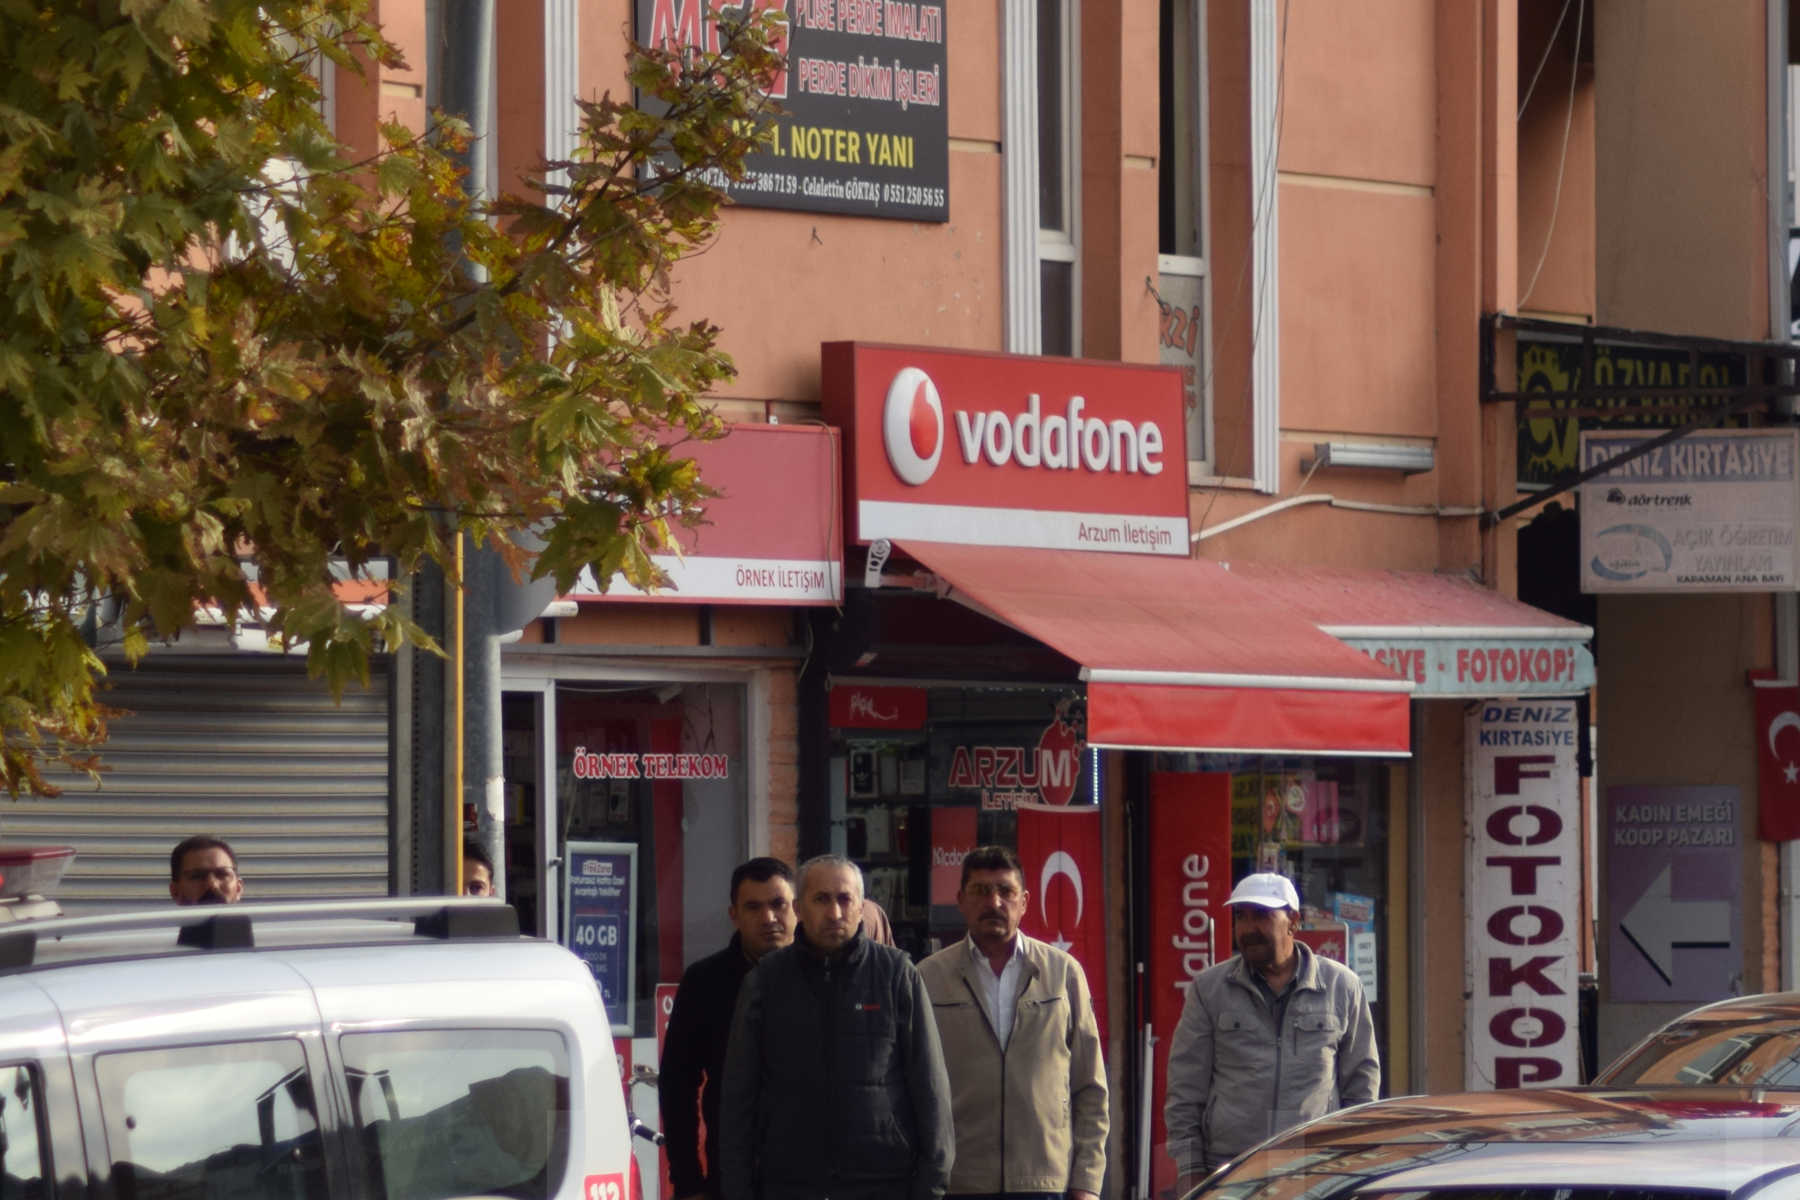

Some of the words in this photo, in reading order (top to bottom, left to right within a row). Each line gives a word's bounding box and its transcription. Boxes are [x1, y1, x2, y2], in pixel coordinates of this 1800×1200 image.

[838, 0, 883, 36] PERDE
[885, 0, 942, 44] İMALATI
[798, 57, 847, 96] PERDE
[848, 55, 892, 101] DİKİM
[894, 59, 940, 110] İŞLERİ
[791, 125, 861, 165] NOTER
[866, 132, 914, 169] YANI
[803, 175, 845, 198] Celalettin
[845, 177, 881, 208] GÖKTAŞ
[955, 392, 1164, 475] vodafone
[1591, 444, 1664, 476] DENİZ
[1670, 441, 1791, 477] KIRTASİYE
[1077, 520, 1118, 547] Arzum
[1121, 521, 1173, 549] İletişim
[735, 563, 775, 588] ÖRNEK
[777, 565, 825, 593] İLETİŞİM
[1455, 645, 1576, 684] FOTOKOPİ
[1482, 704, 1572, 724] DENİZ
[1478, 728, 1575, 748] KIRTASİYE
[572, 745, 641, 780] ÖRNEK
[642, 752, 729, 779] TELEKOM
[947, 743, 1072, 789] ARZUM
[1615, 803, 1672, 824] KADIN
[1674, 799, 1734, 824] EMEĞİ
[1614, 828, 1664, 847] KOOP
[1666, 827, 1734, 847] PAZARI
[574, 925, 595, 947] 40
[596, 924, 618, 947] GB
